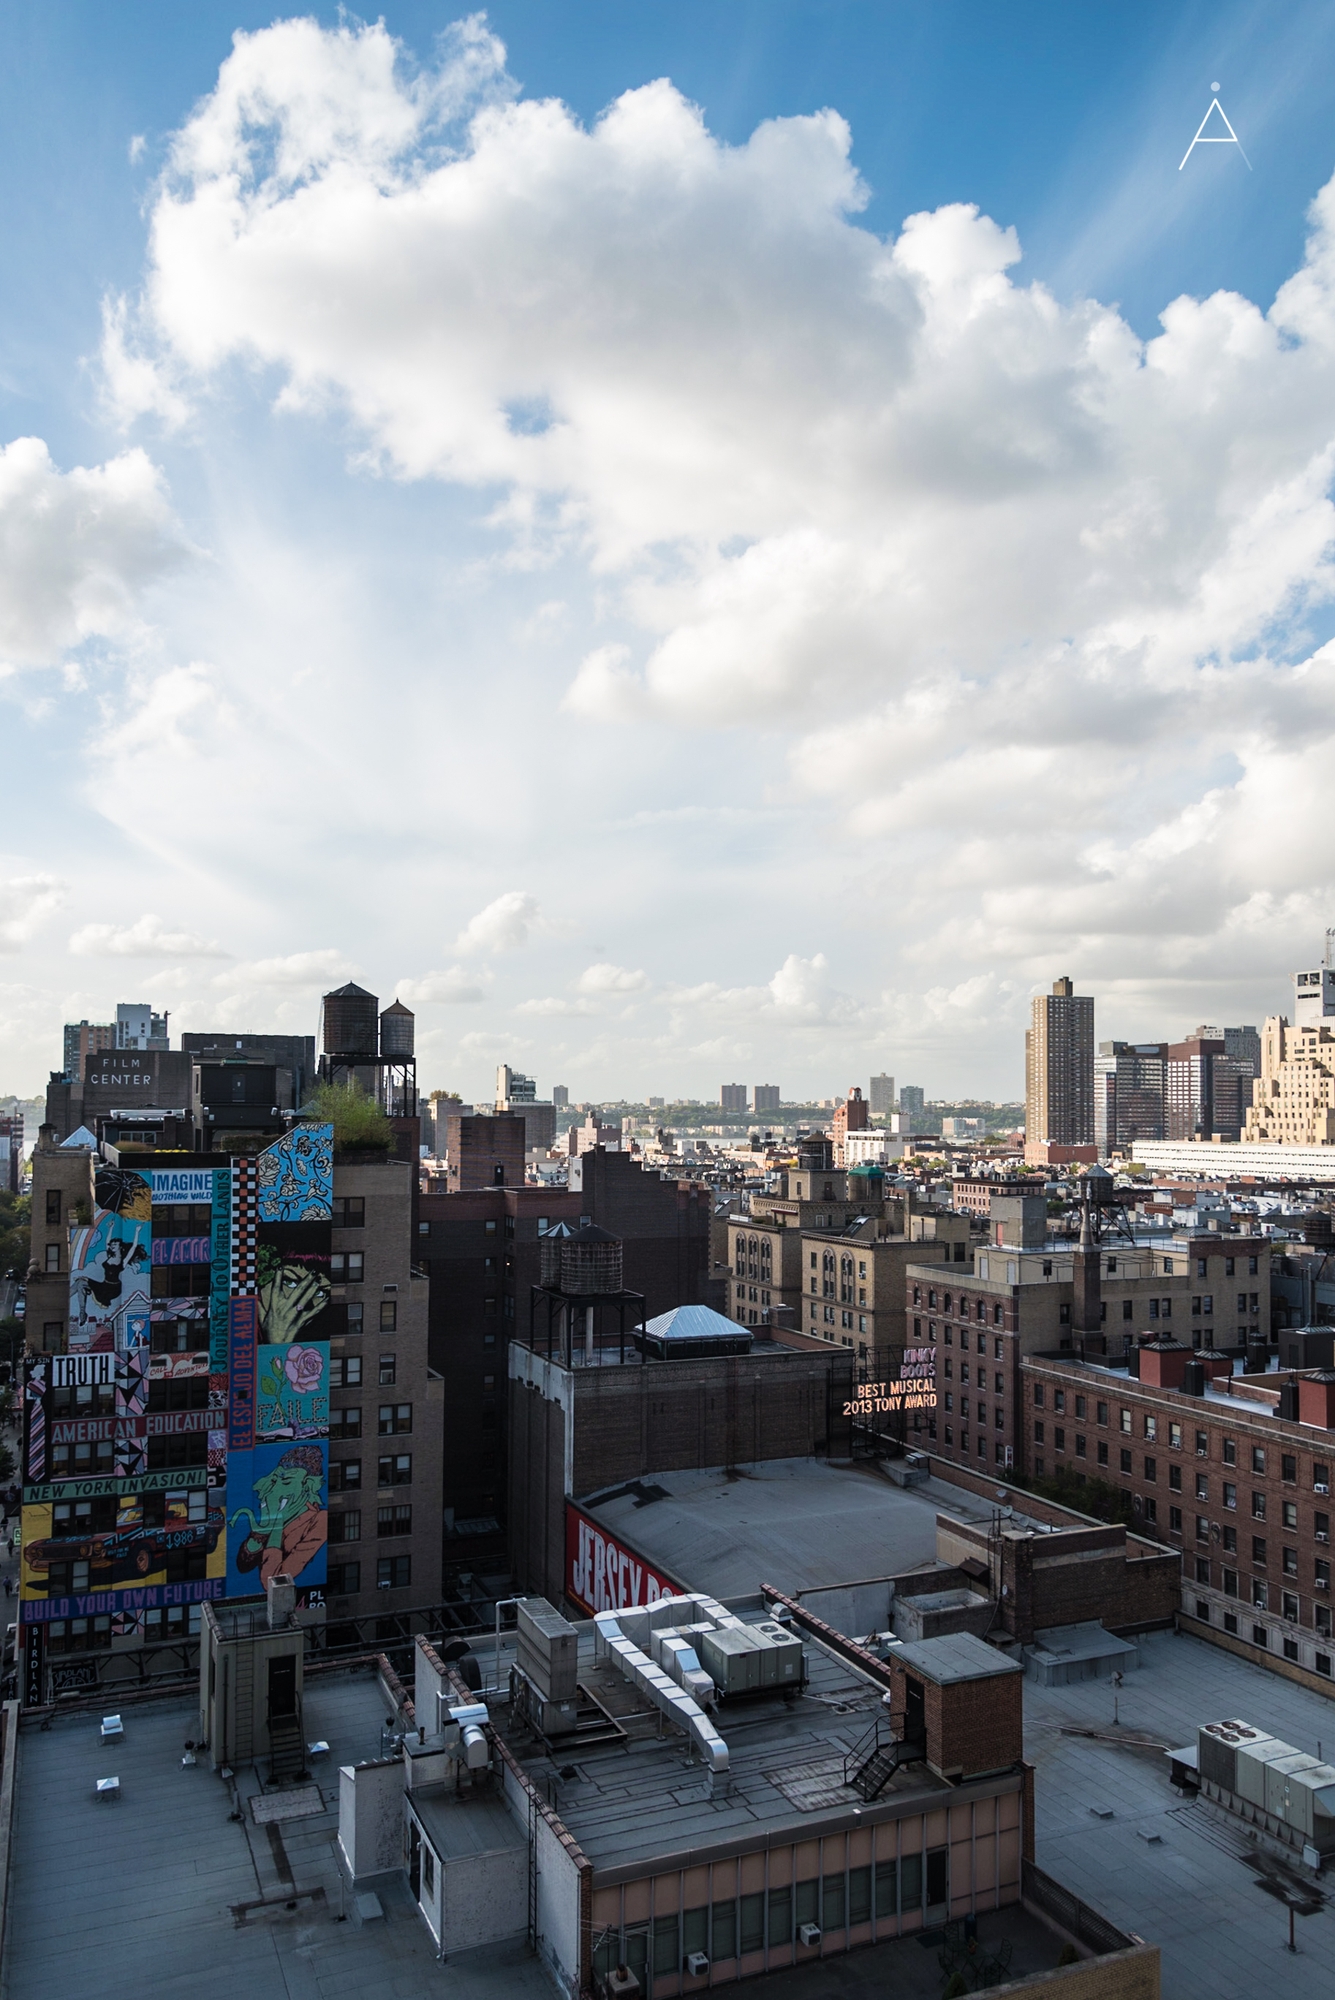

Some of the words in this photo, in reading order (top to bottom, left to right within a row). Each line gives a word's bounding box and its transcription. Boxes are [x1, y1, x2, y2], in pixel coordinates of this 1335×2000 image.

[103, 1059, 140, 1067] FILM
[91, 1074, 151, 1085] CENTER
[152, 1174, 213, 1191] IMAGINE
[213, 1171, 230, 1219] LANDS
[152, 1192, 188, 1201] NOTHING
[191, 1192, 212, 1200] WILD
[152, 1239, 168, 1264] EL
[170, 1238, 210, 1264] AMOR
[212, 1222, 229, 1271] OTHER
[210, 1297, 229, 1372] JOURNEY
[903, 1347, 936, 1363] KINKY
[56, 1355, 109, 1386] TRUTH
[150, 1366, 167, 1376] CALL
[900, 1363, 936, 1379] BOOTS
[858, 1382, 886, 1398] BEST
[890, 1378, 936, 1395] MUSICAL
[257, 1397, 328, 1429] FAILE
[842, 1400, 872, 1416] 2013
[874, 1396, 902, 1412] TONY
[904, 1394, 937, 1409] AWARD
[52, 1419, 136, 1444] AMERICAN
[145, 1410, 225, 1435] EDUCATION
[29, 1485, 65, 1500] NEW
[75, 1480, 114, 1496] YORK
[121, 1471, 203, 1493] INVASION!
[573, 1519, 642, 1612] JERSEY
[24, 1599, 69, 1621] BUILD
[76, 1592, 116, 1614] YOUR
[122, 1587, 158, 1609] OWN
[163, 1579, 223, 1603] FUTURE
[30, 1627, 39, 1704] BIRDLAN
